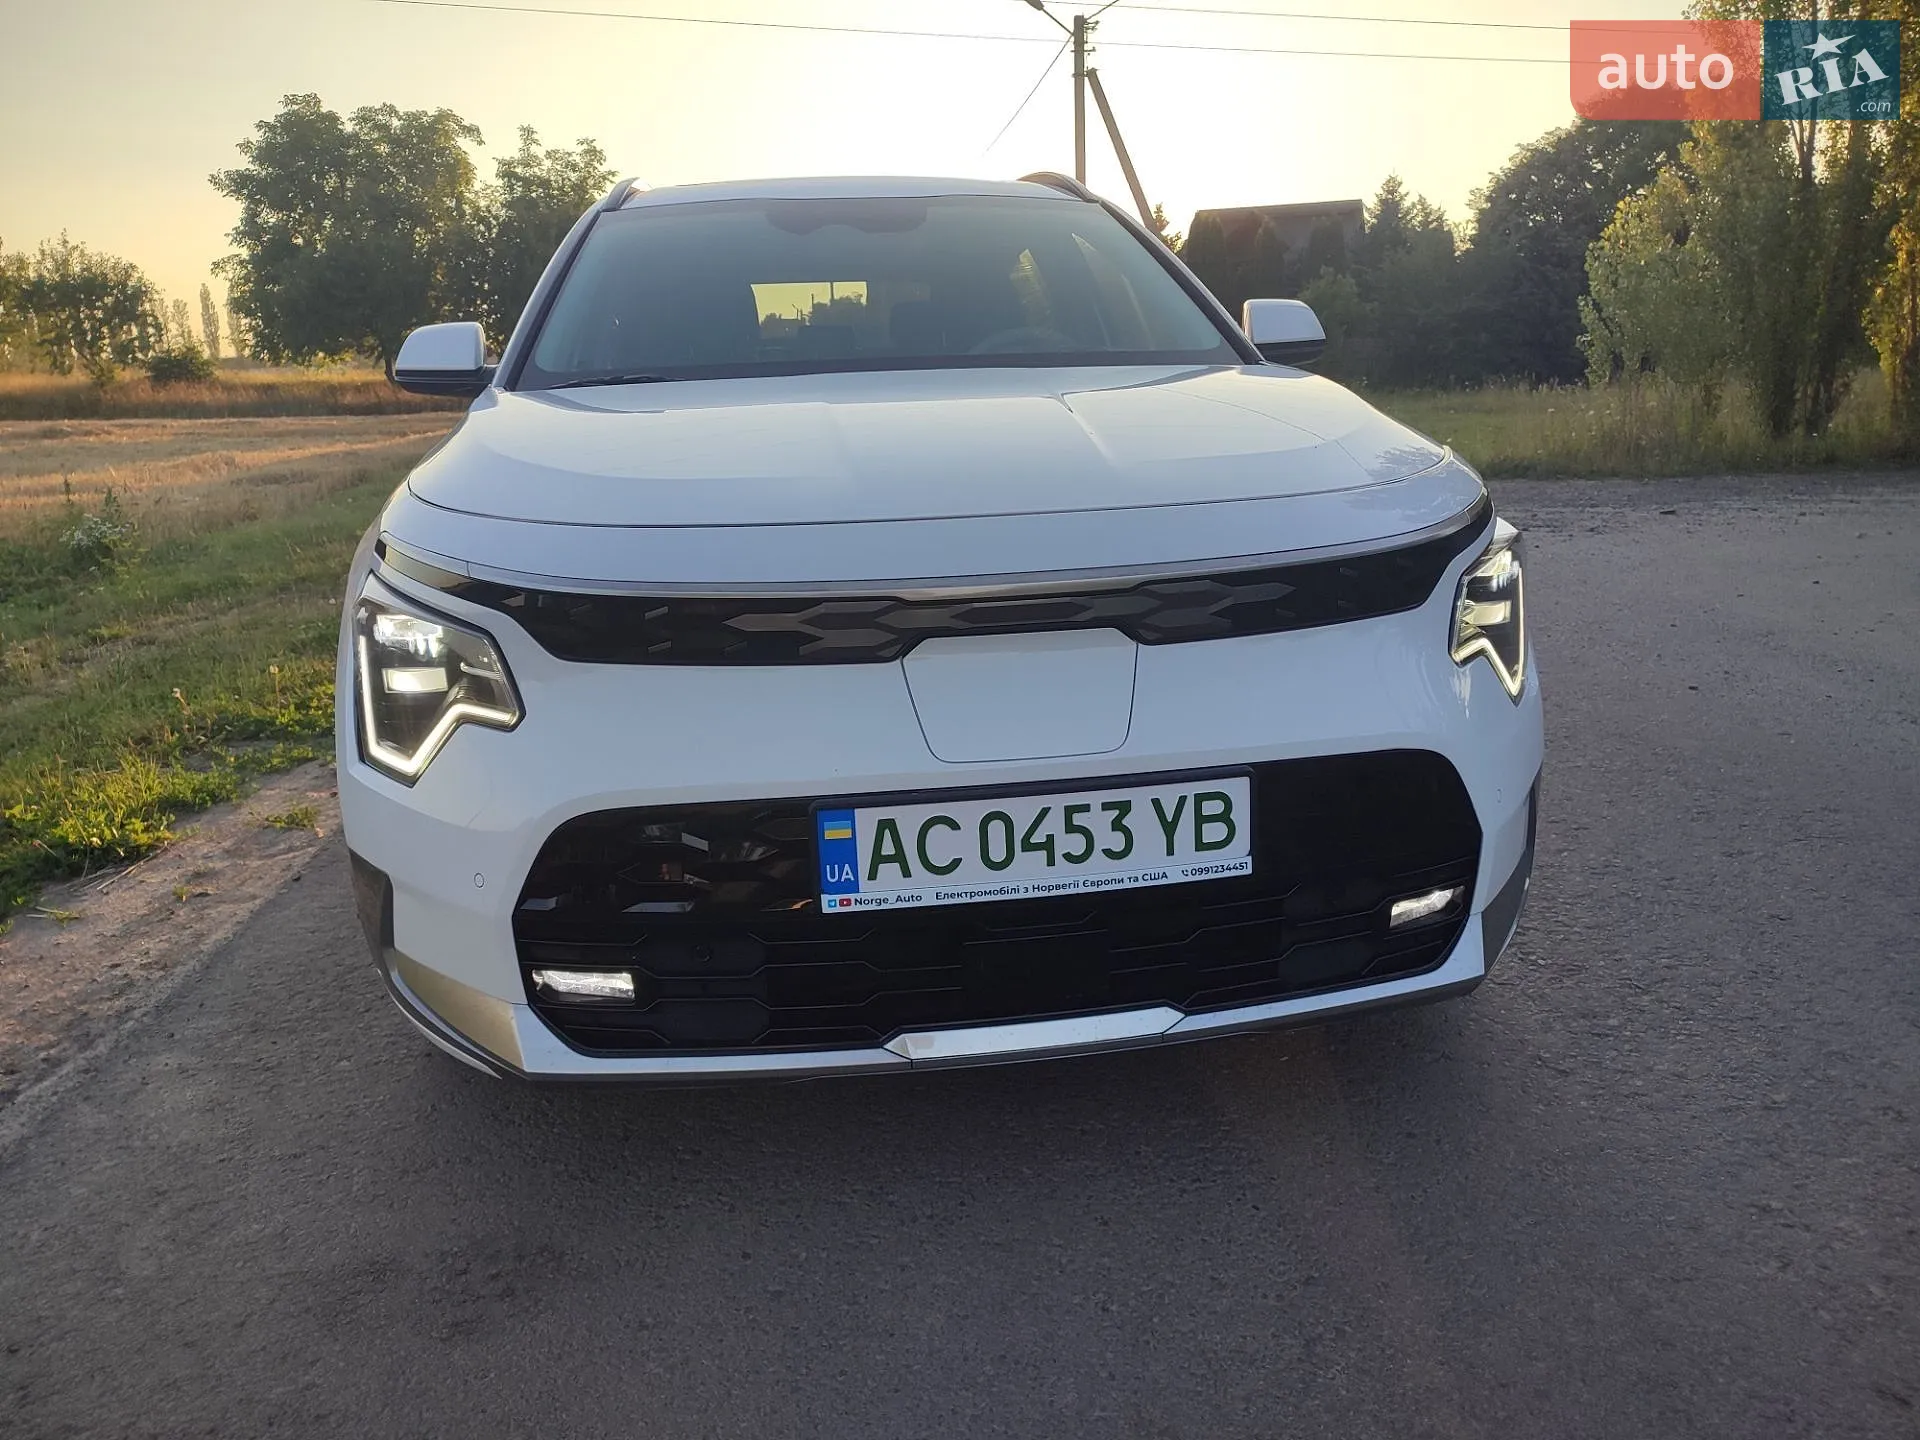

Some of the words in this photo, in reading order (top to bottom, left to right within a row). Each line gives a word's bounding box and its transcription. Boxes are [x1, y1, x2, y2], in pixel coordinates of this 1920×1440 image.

[866, 814, 963, 881] AC
[978, 799, 1134, 871] 0453
[1151, 790, 1237, 857] YB
[825, 863, 855, 884] UA
[1190, 861, 1249, 877] 0991234451
[935, 885, 1021, 901] Електромобілі
[1022, 885, 1029, 894] з
[1032, 880, 1080, 894] Норвегії
[1082, 876, 1125, 890] Європи
[1126, 875, 1140, 884] та
[1142, 871, 1169, 882] США
[854, 894, 923, 908] Norge_Auto
